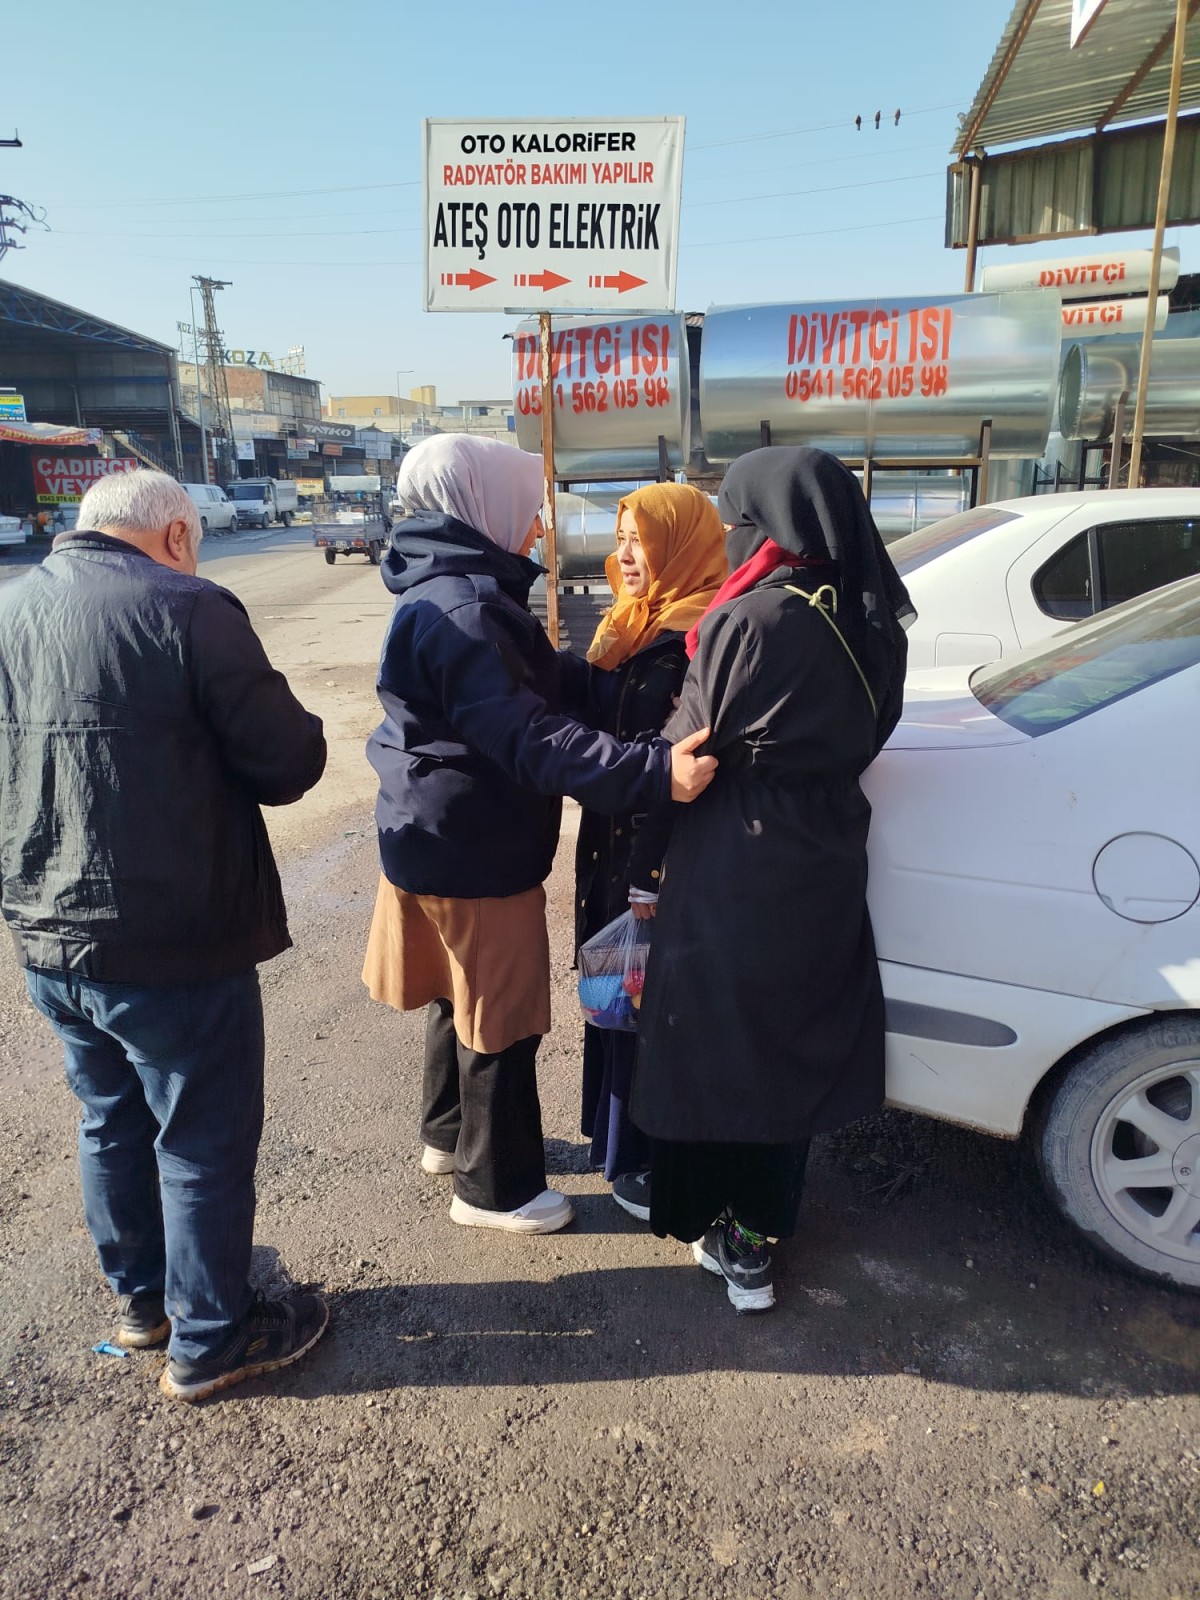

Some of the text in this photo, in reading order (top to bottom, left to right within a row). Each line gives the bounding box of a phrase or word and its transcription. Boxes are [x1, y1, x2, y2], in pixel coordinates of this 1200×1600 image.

[461, 132, 636, 154] OTO KALORiFER
[443, 159, 654, 186] RADYATÖR BAKIMI YAPILIR
[433, 202, 661, 260] ATEŞ OTO ELEKTRiK
[1061, 304, 1124, 326] ViTÇi
[631, 323, 671, 375] ISI
[908, 307, 952, 364] ISI
[221, 350, 272, 365] KOZA
[517, 376, 672, 416] 051 562 05 98
[785, 364, 948, 402] 0541 562 05 98
[302, 424, 352, 437] TAYKO
[45, 478, 96, 495] VEY
